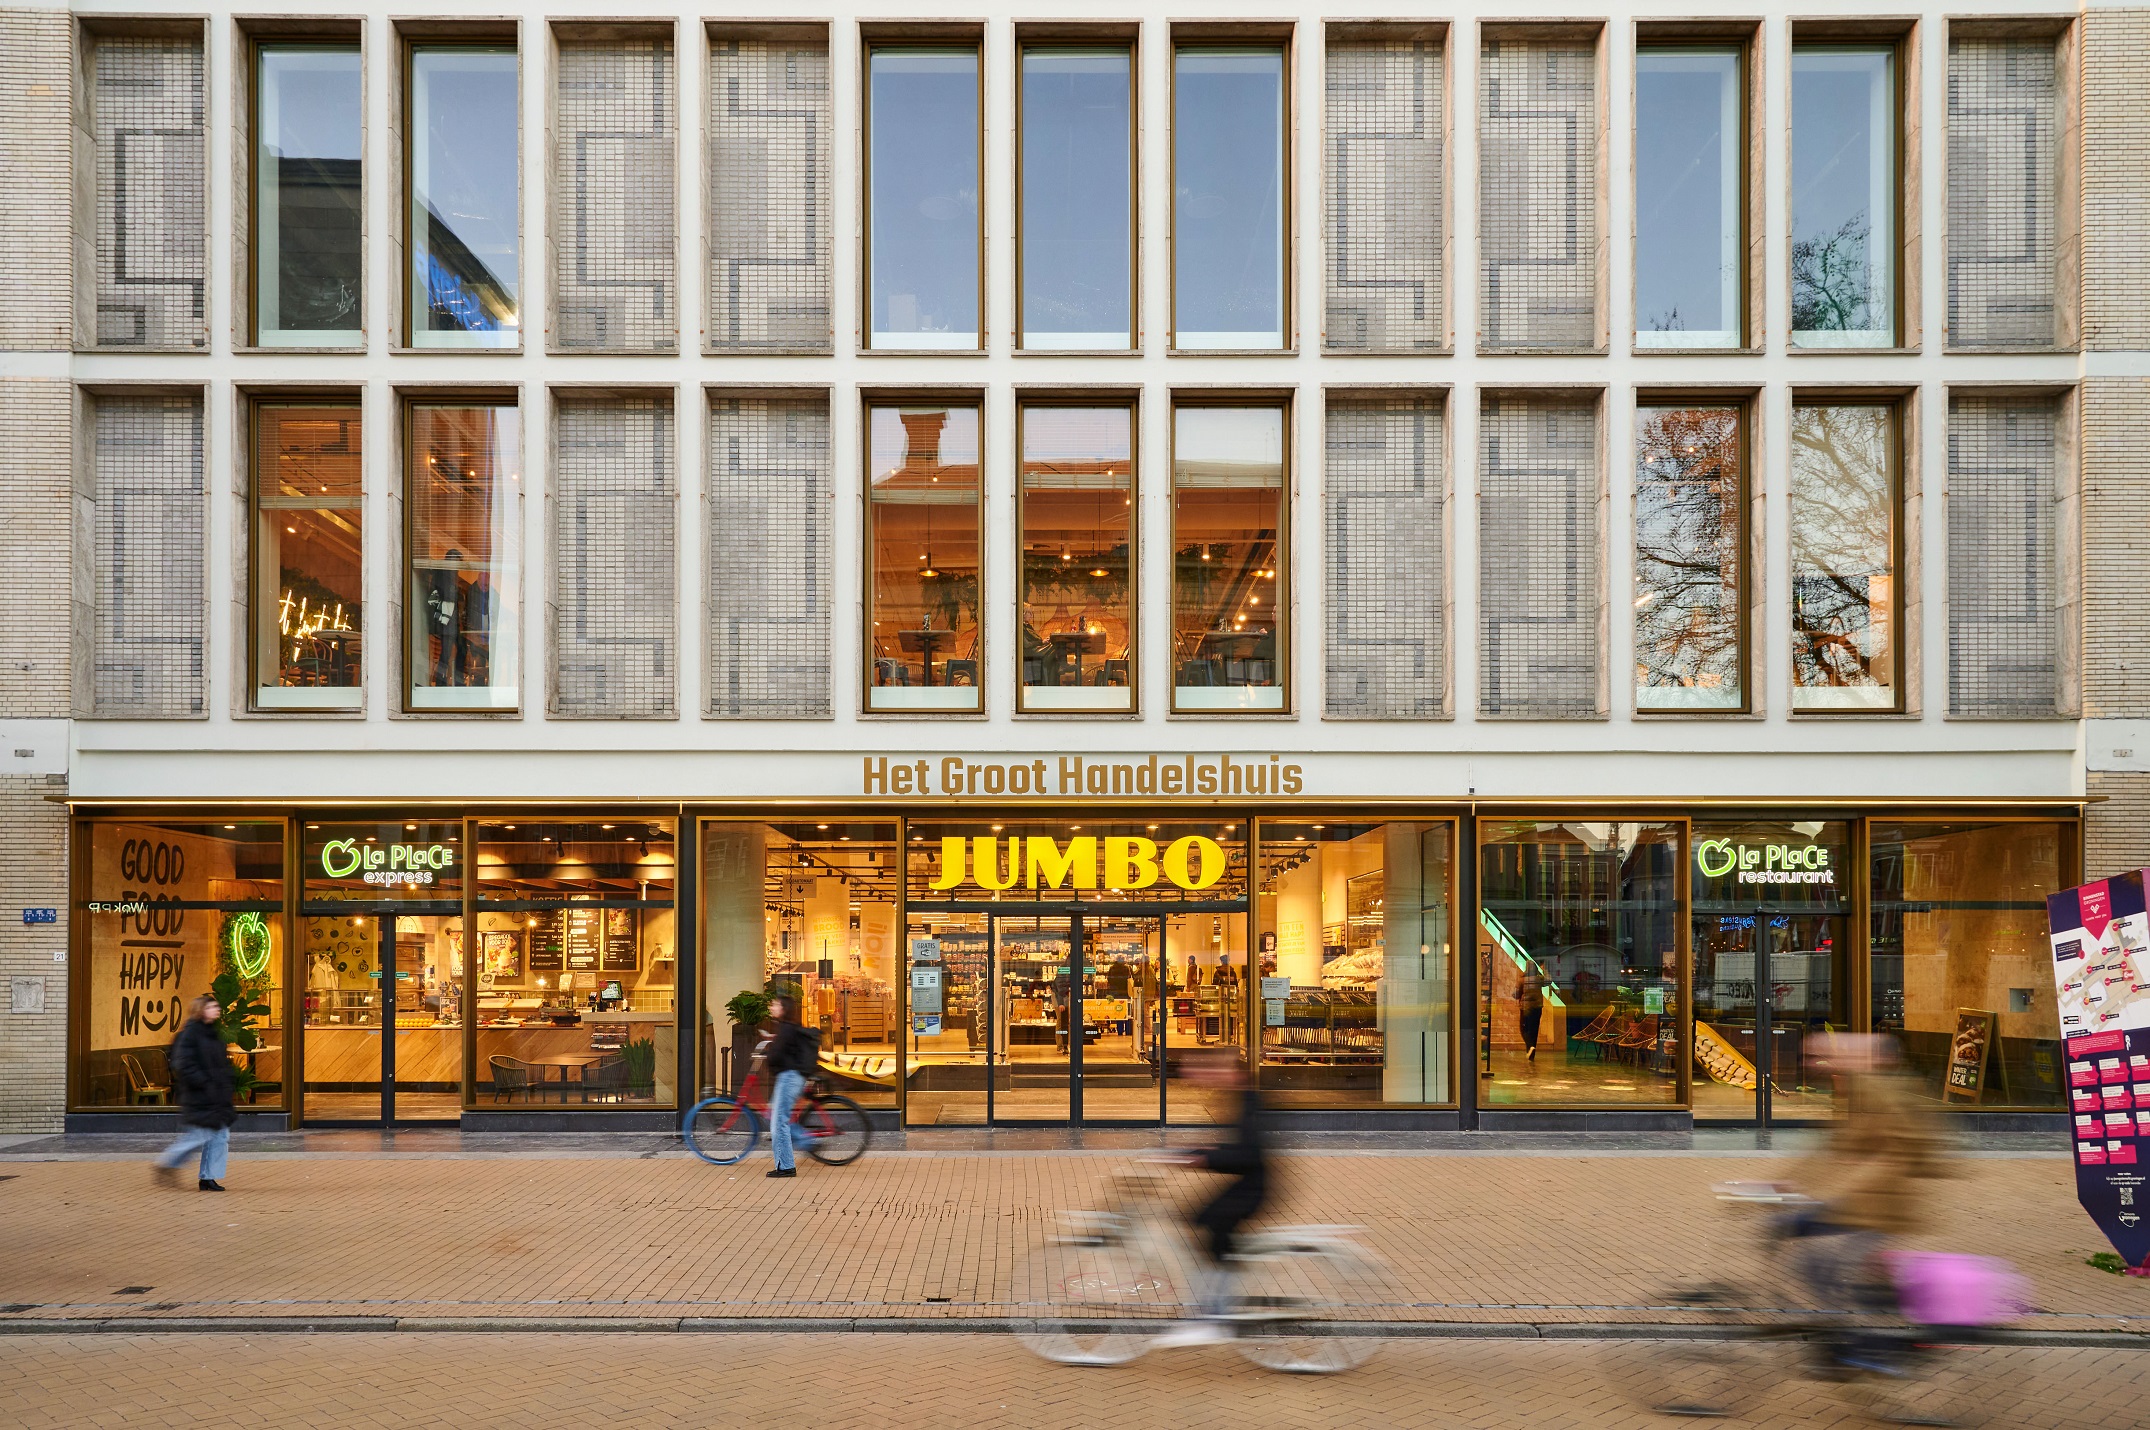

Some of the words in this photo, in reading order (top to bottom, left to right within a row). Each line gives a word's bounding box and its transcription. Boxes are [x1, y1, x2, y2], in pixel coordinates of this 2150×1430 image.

[863, 756, 930, 795] Het
[941, 756, 1047, 795] Groot
[1058, 754, 1303, 795] Handelshuis
[120, 838, 185, 885] GOOD
[928, 835, 1226, 890] JUMBO
[363, 871, 433, 887] express
[1738, 869, 1834, 884] restaurant
[120, 890, 185, 937] FOOD
[813, 921, 845, 932] BROOD
[119, 952, 185, 990] HAPPY
[1660, 1032, 1675, 1041] DEAL
[1951, 1072, 1967, 1086] DEAL
